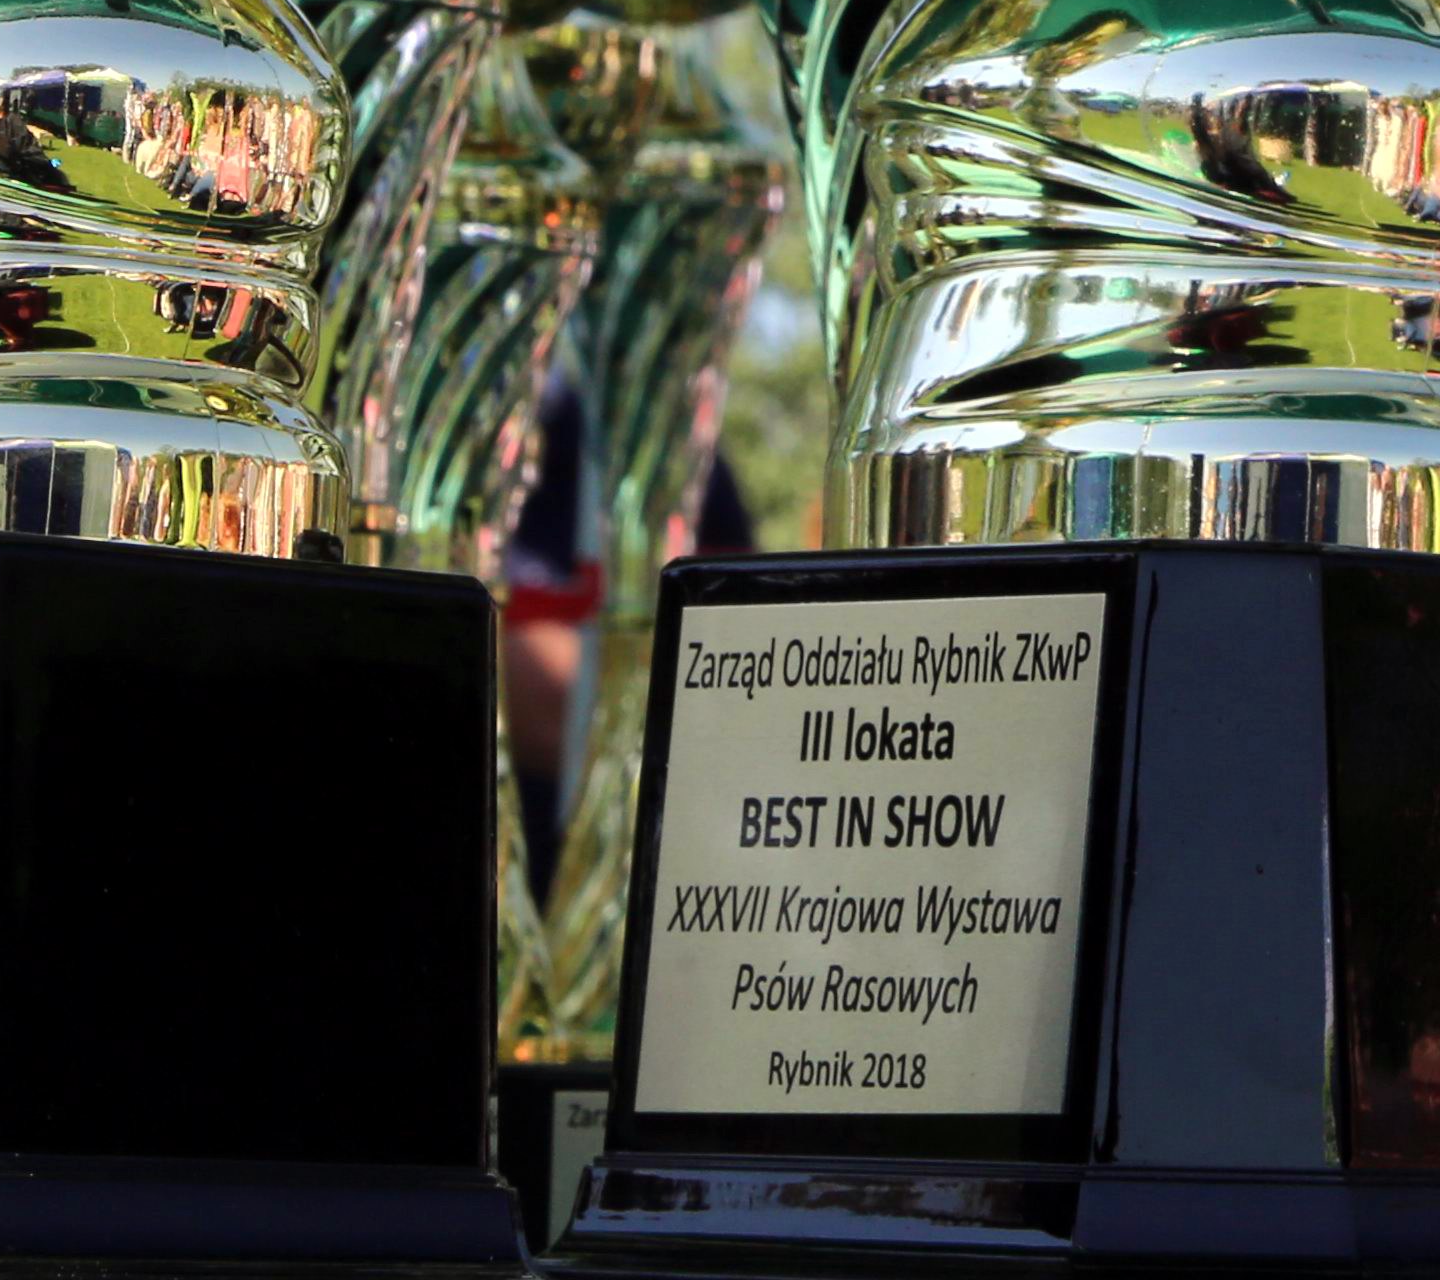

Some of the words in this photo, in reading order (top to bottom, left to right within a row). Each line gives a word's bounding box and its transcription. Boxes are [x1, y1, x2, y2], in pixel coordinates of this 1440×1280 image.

[685, 638, 775, 700] Zarząd
[783, 635, 903, 687] Oddziału
[912, 631, 1006, 696] Rybnik
[1013, 632, 1091, 681] ZKwP
[801, 711, 833, 761] III
[844, 706, 954, 761] lokata
[740, 796, 827, 848] BEST
[836, 796, 875, 847] IN
[884, 795, 1005, 848] SHOW
[667, 886, 770, 932] XXXVII
[776, 886, 904, 945] Krajowa
[917, 886, 1061, 945] Wystawa
[732, 961, 814, 1011] Psów
[821, 963, 978, 1025] Rasowych
[769, 1050, 853, 1094] Rybnik
[861, 1053, 926, 1089] 2018
[568, 1103, 607, 1129] Zar
